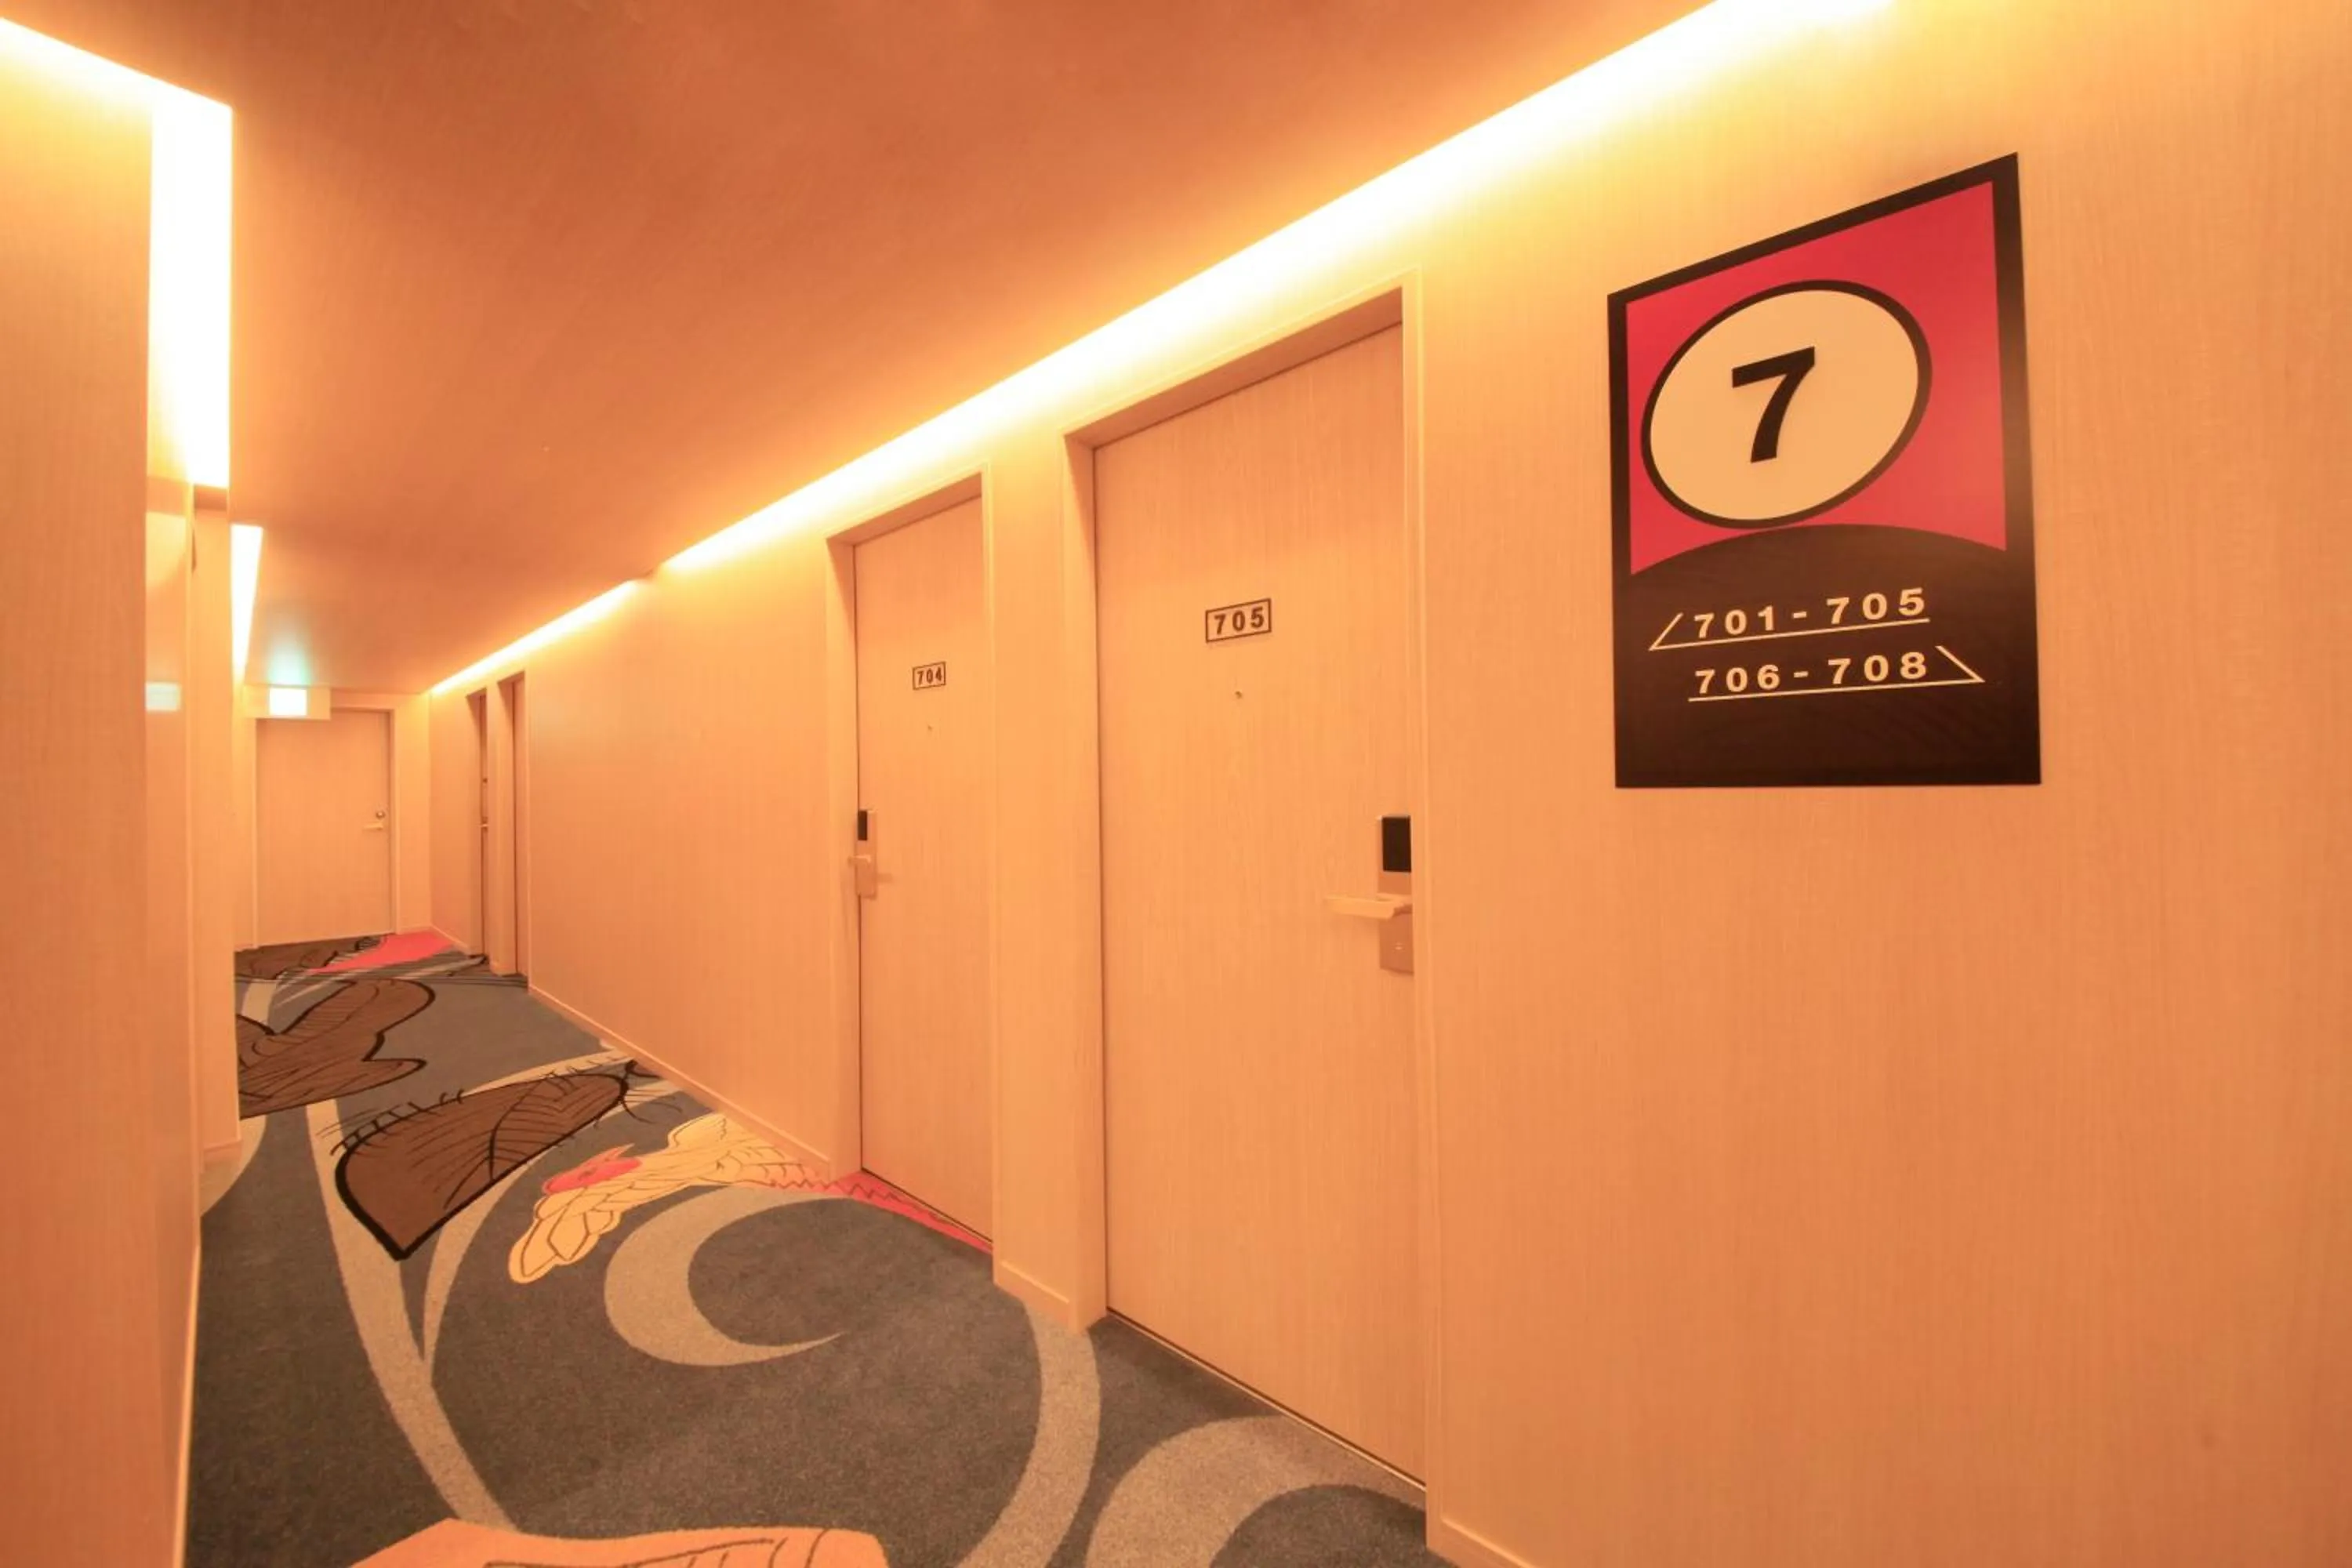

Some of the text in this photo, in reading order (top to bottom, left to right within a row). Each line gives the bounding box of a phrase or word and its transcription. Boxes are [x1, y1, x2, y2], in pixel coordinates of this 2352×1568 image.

[1731, 346, 1816, 463] 7
[1214, 606, 1265, 635] 705
[916, 666, 942, 685] 704
